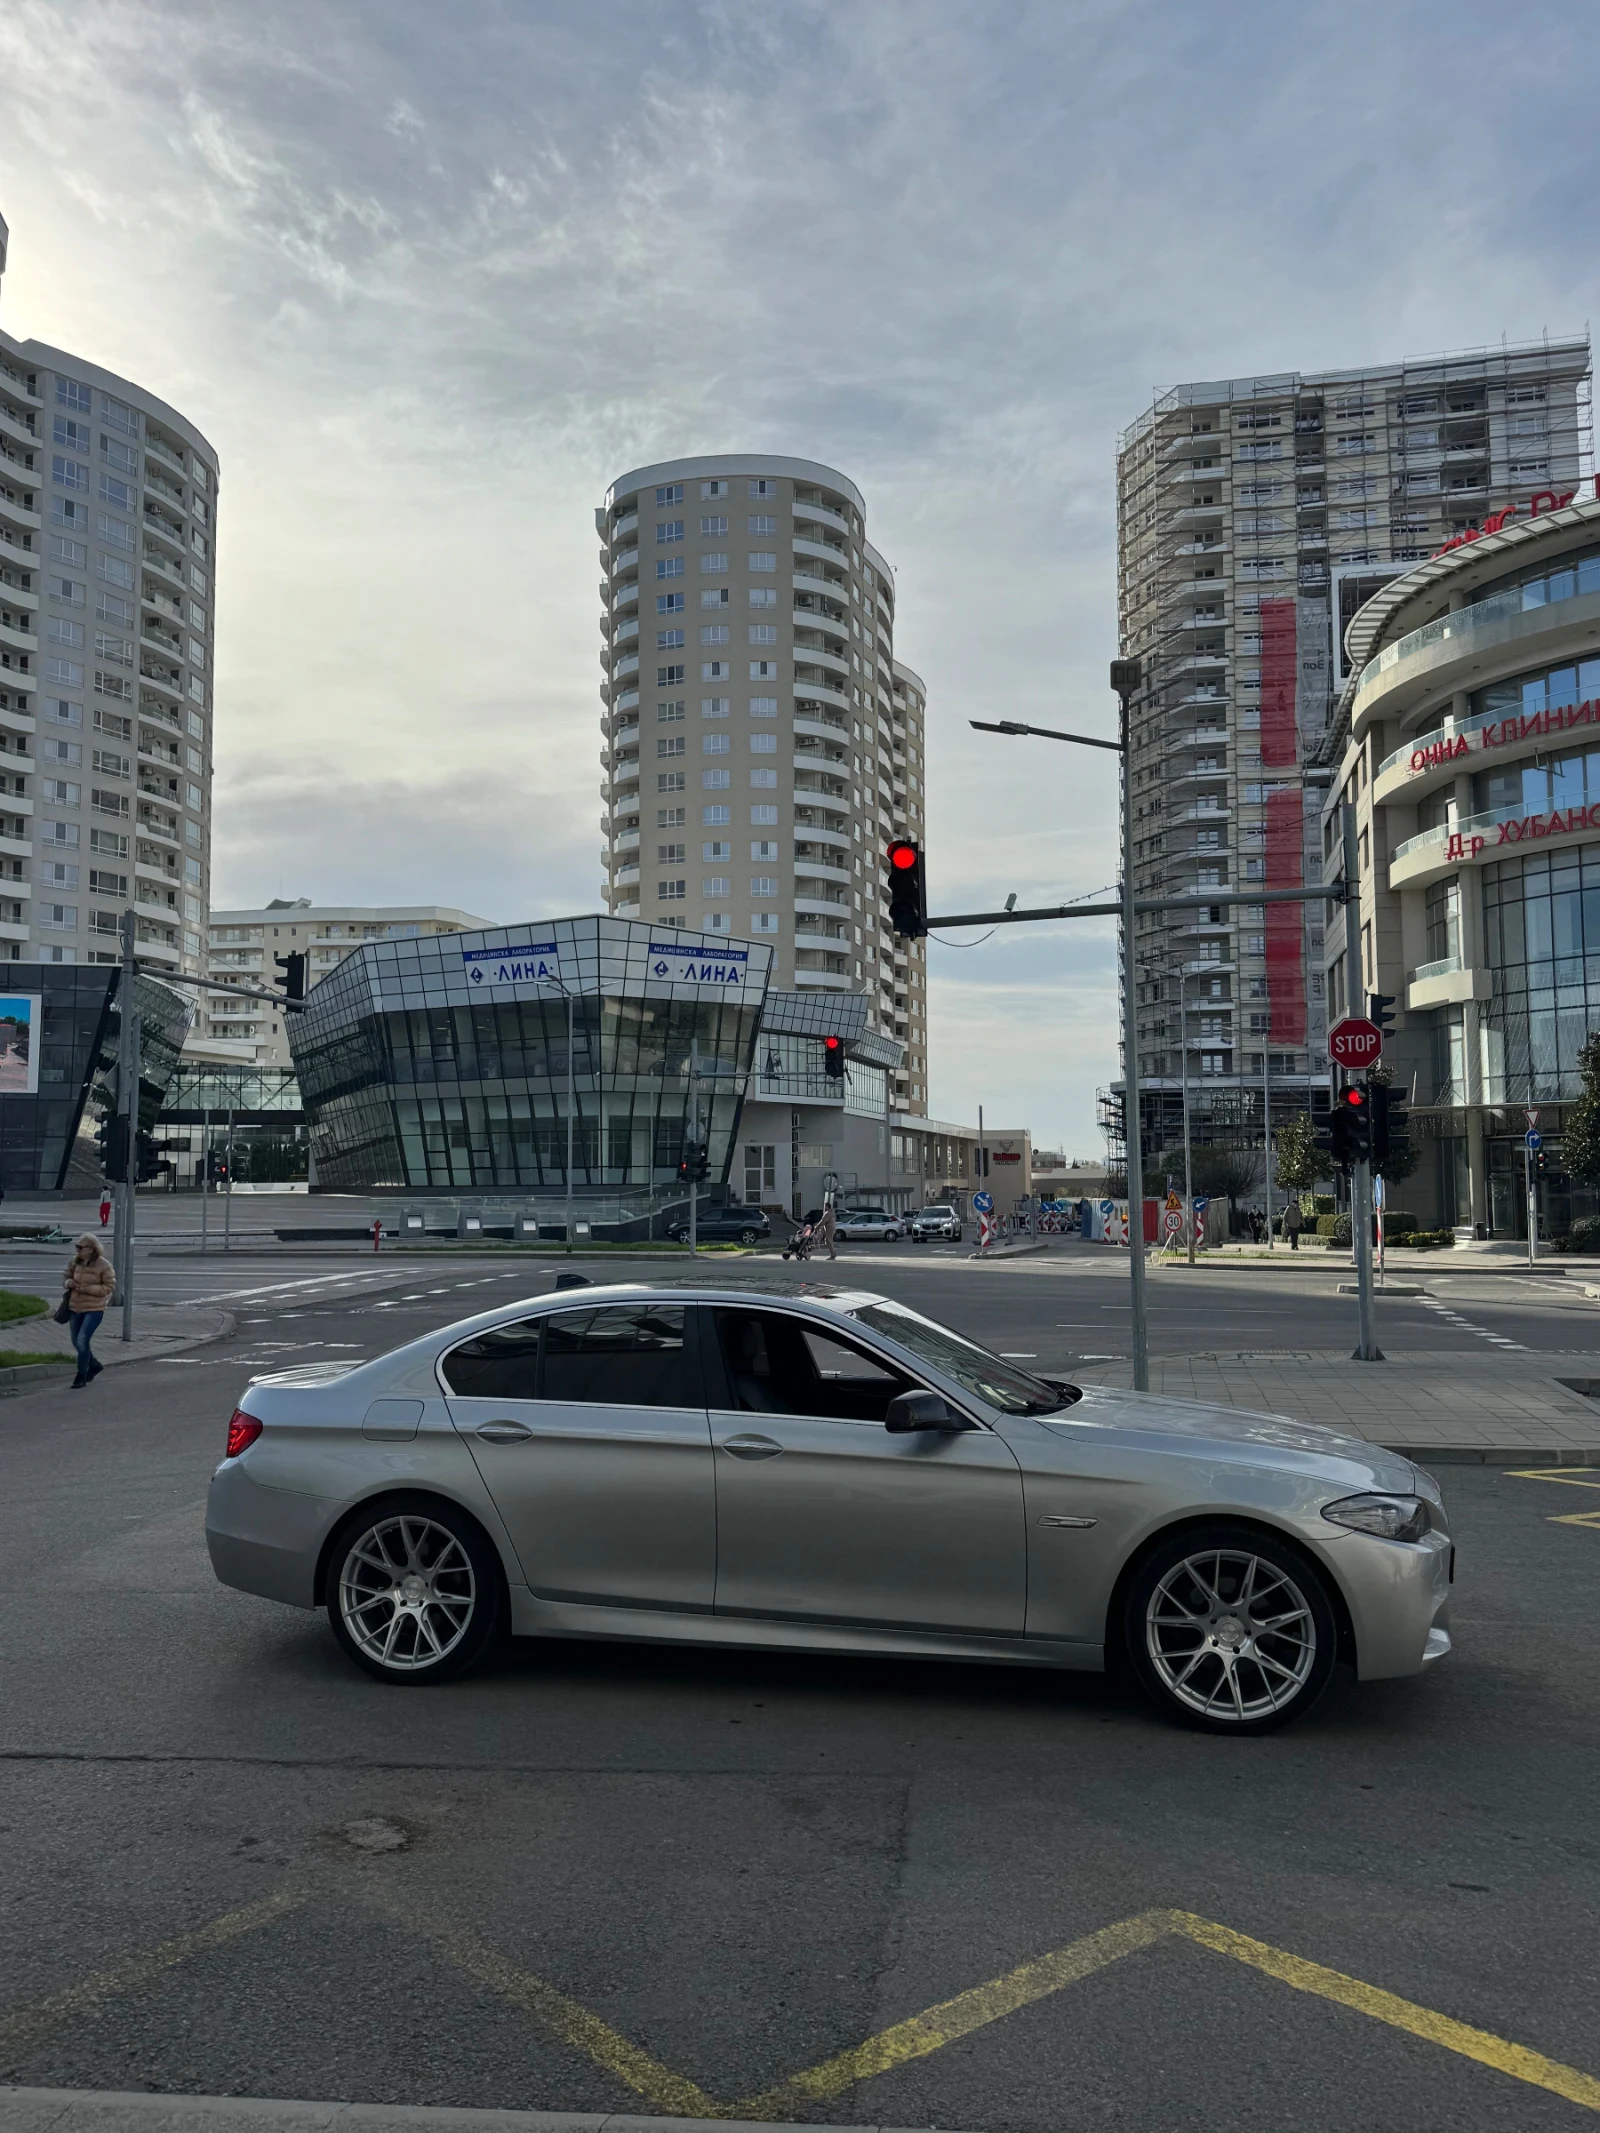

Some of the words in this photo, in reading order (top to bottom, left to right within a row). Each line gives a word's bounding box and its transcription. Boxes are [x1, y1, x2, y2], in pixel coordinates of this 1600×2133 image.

[1411, 733, 1470, 771] ОЧНА
[1447, 833, 1484, 861] Д-р
[653, 946, 697, 956] МЕДИЦИНСКА
[1335, 1034, 1376, 1053] STOP
[1168, 1216, 1179, 1227] 30
